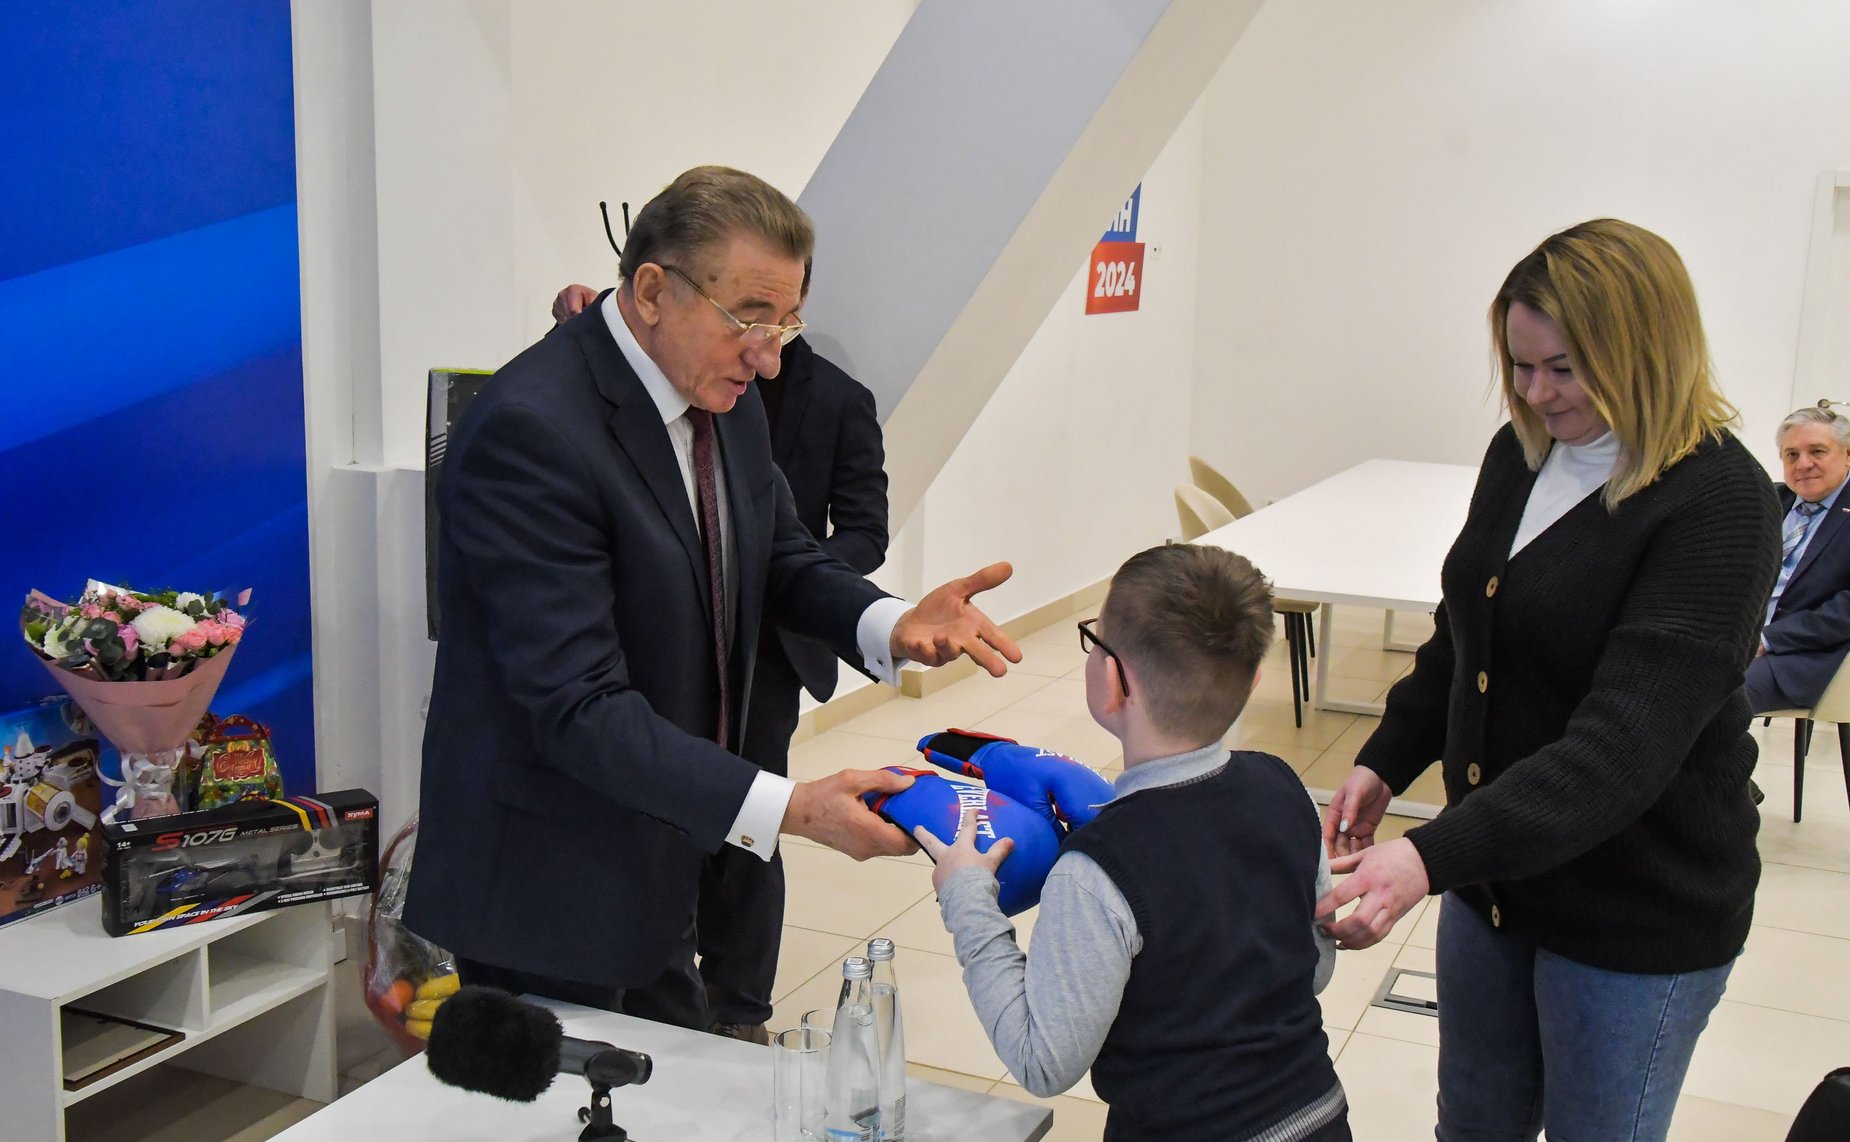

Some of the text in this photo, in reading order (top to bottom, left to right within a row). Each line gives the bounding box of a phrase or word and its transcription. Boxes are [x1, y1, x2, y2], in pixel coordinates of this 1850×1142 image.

[1094, 261, 1136, 298] 2024
[151, 823, 299, 852] S107G METAL SERIES
[175, 911, 200, 920] SPACE
[223, 904, 239, 912] SKY
